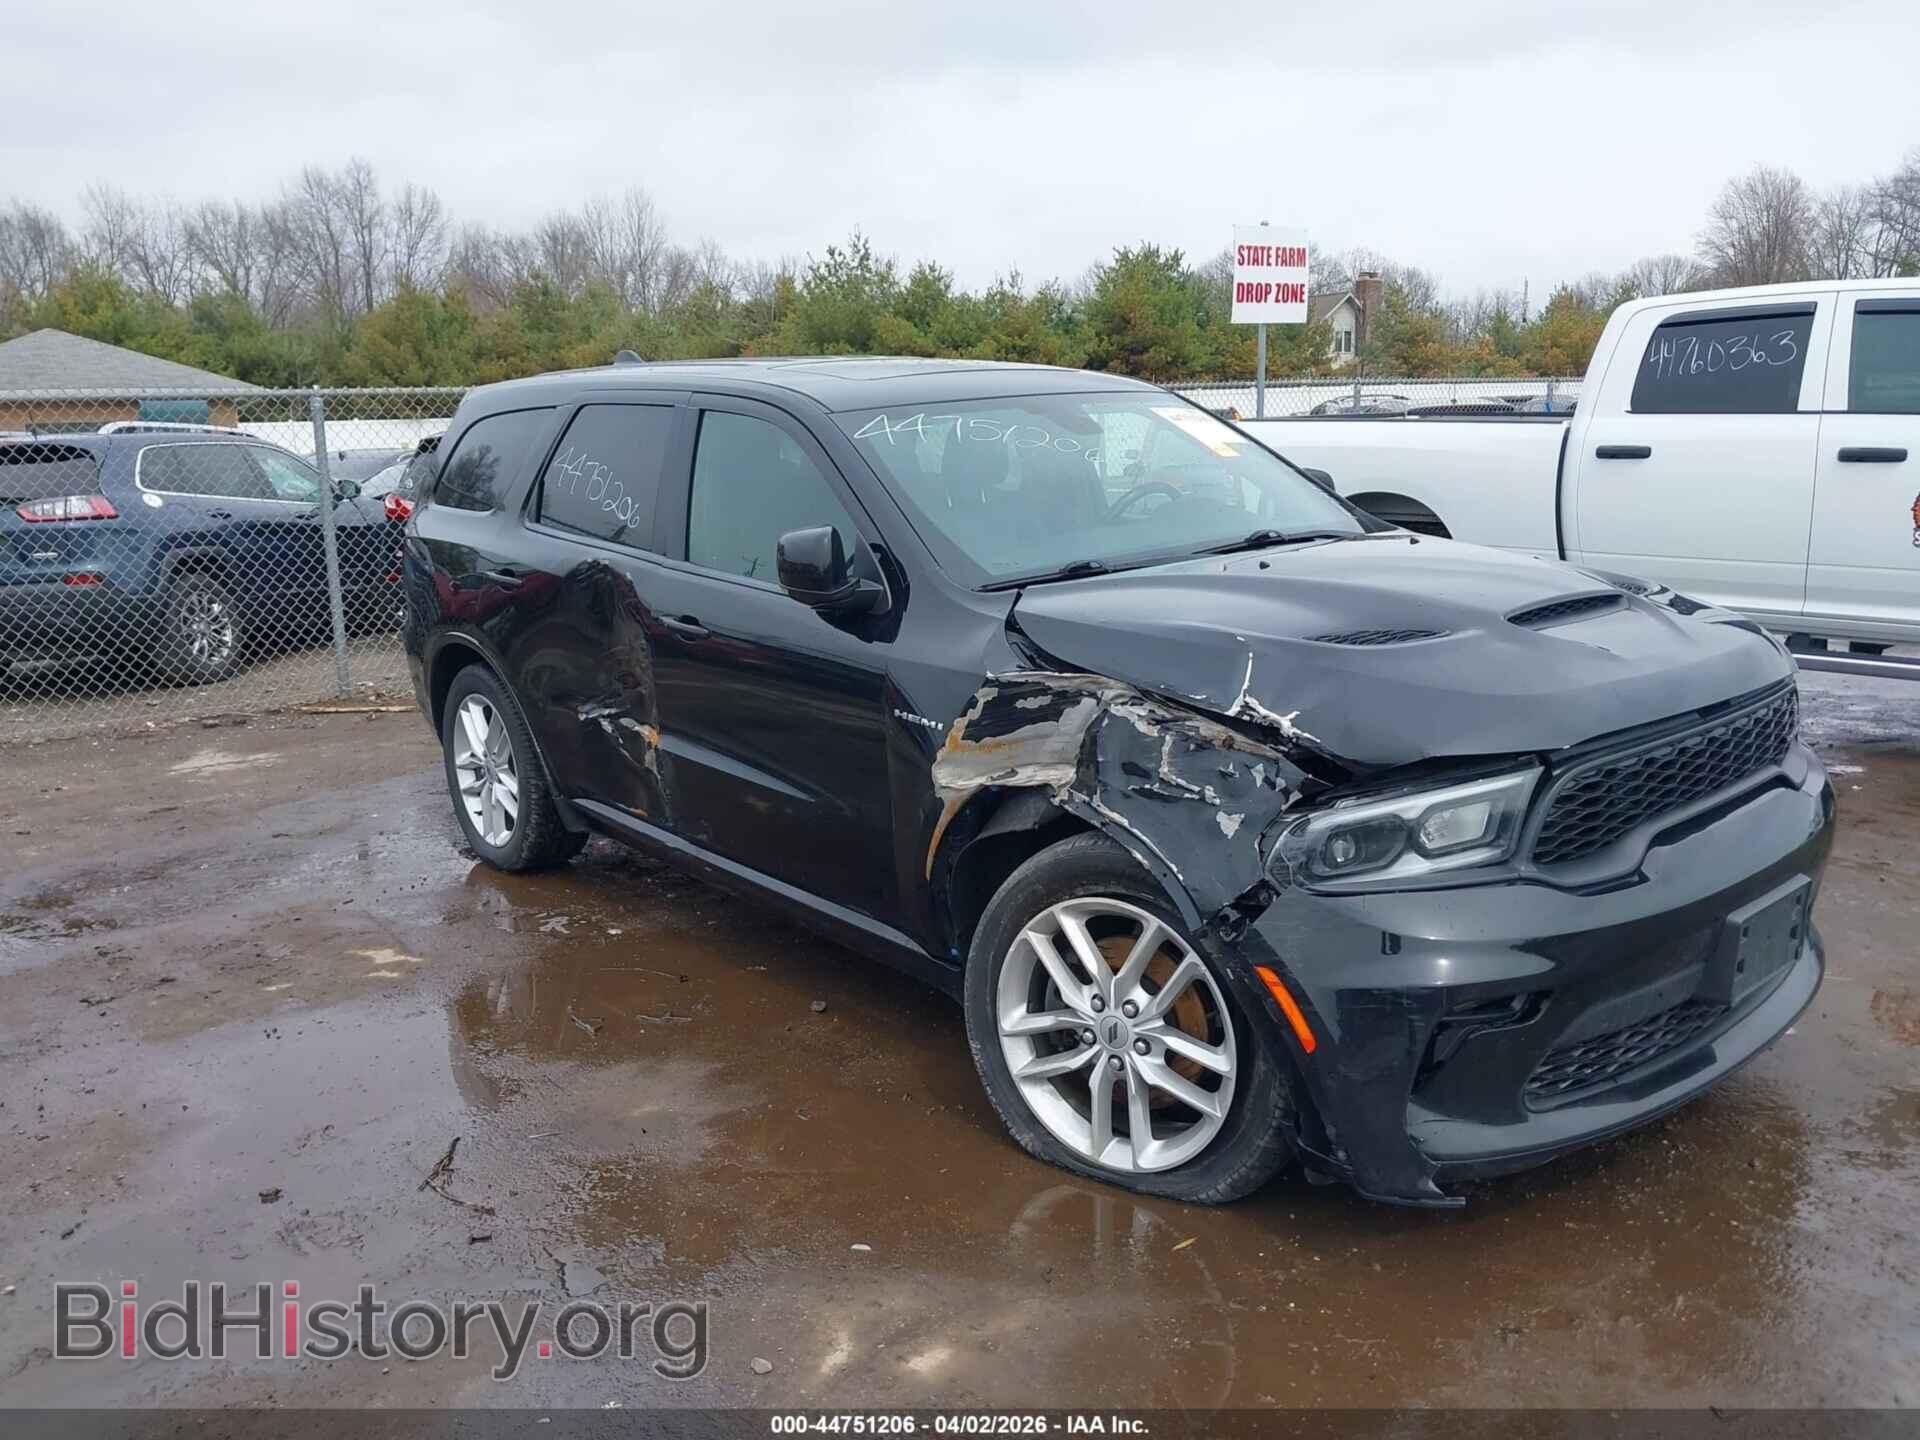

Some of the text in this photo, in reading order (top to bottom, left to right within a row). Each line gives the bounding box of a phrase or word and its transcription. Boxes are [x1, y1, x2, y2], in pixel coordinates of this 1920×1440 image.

[1237, 245, 1306, 268] STATE FARM
[1236, 282, 1305, 304] DROP ZONE
[1649, 330, 1798, 380] 44760363
[554, 447, 640, 528] 44751206
